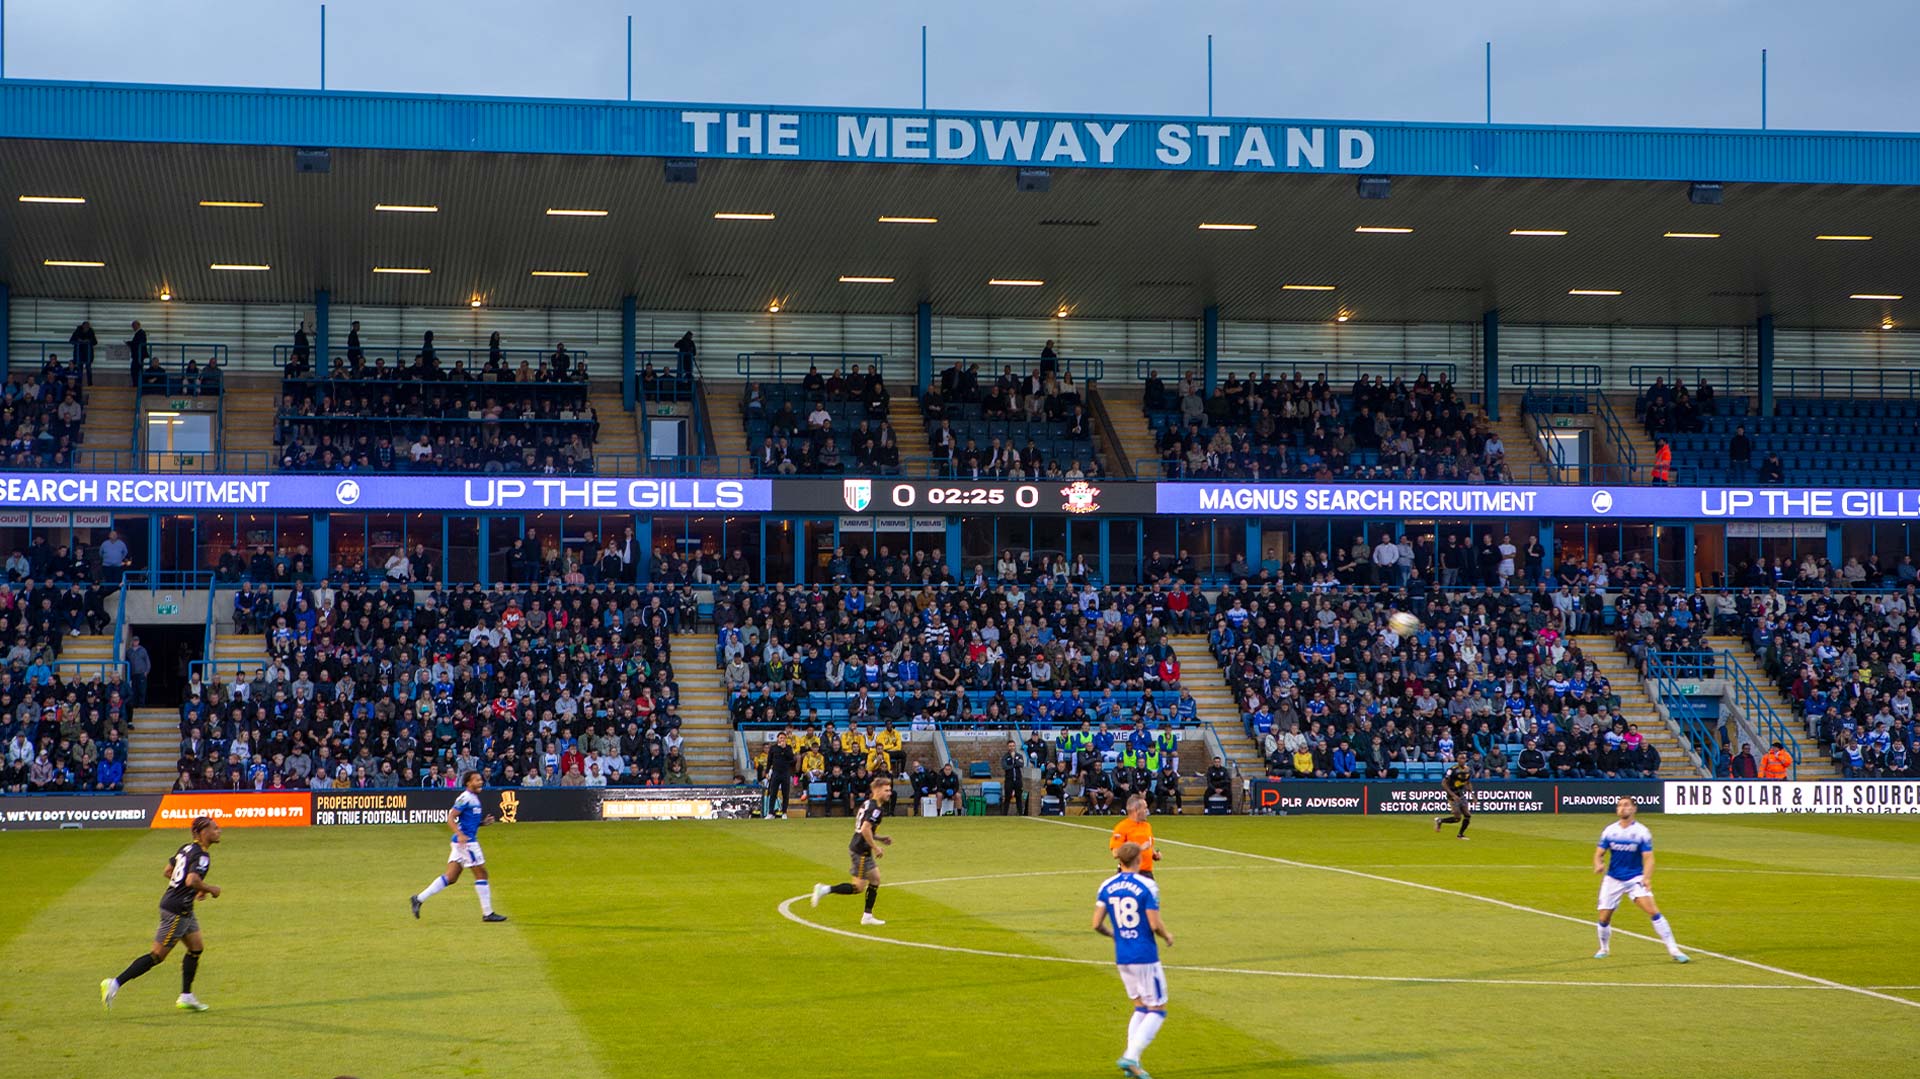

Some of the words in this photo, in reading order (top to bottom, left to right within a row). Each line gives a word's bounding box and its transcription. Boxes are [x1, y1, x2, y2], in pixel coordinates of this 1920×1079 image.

[682, 111, 799, 156] THE
[837, 115, 1130, 163] MEDWAY
[1155, 123, 1375, 169] STAND
[106, 480, 270, 503] RECRUITMENT
[465, 479, 526, 507] UP
[533, 480, 618, 508] THE
[628, 480, 744, 508] GILLS
[892, 484, 916, 507] 0
[928, 488, 1005, 505] 02:25
[1015, 485, 1039, 508] 0
[1199, 488, 1298, 510] MAGNUS
[1304, 488, 1393, 511] SEARCH
[1399, 490, 1537, 512] RECRUITMENT
[1701, 490, 1754, 515] UP
[1759, 490, 1834, 516] THE
[1841, 490, 1920, 517] GILL
[0, 515, 27, 523] auvill
[35, 514, 68, 524] Bauvill
[76, 514, 109, 524] Bauvill
[317, 795, 407, 809] PROPERFOOTIE.COM
[1281, 797, 1302, 807] PLR
[1306, 797, 1360, 807] ADVISORY
[1392, 790, 1407, 800] WE
[1408, 790, 1448, 800] SUPPOR
[1477, 790, 1532, 800] EDUCATION
[1676, 785, 1712, 805] RNB
[1722, 785, 1782, 805] SOLAR
[1792, 787, 1802, 805] &
[1813, 785, 1843, 805] AIR
[1380, 801, 1418, 812] SECTOR
[1420, 801, 1453, 812] ACROS
[1483, 801, 1517, 811] SOUTH
[1519, 801, 1543, 811] EAST
[6, 810, 42, 822] WE'VE
[43, 810, 65, 821] GOT
[66, 810, 91, 821] YOU
[91, 809, 146, 820] COVERED!
[161, 809, 187, 819] CALL
[316, 811, 335, 825] FOR
[337, 810, 360, 824] TRUE
[362, 810, 408, 824] FOOTBALL
[1108, 896, 1141, 929] 18
